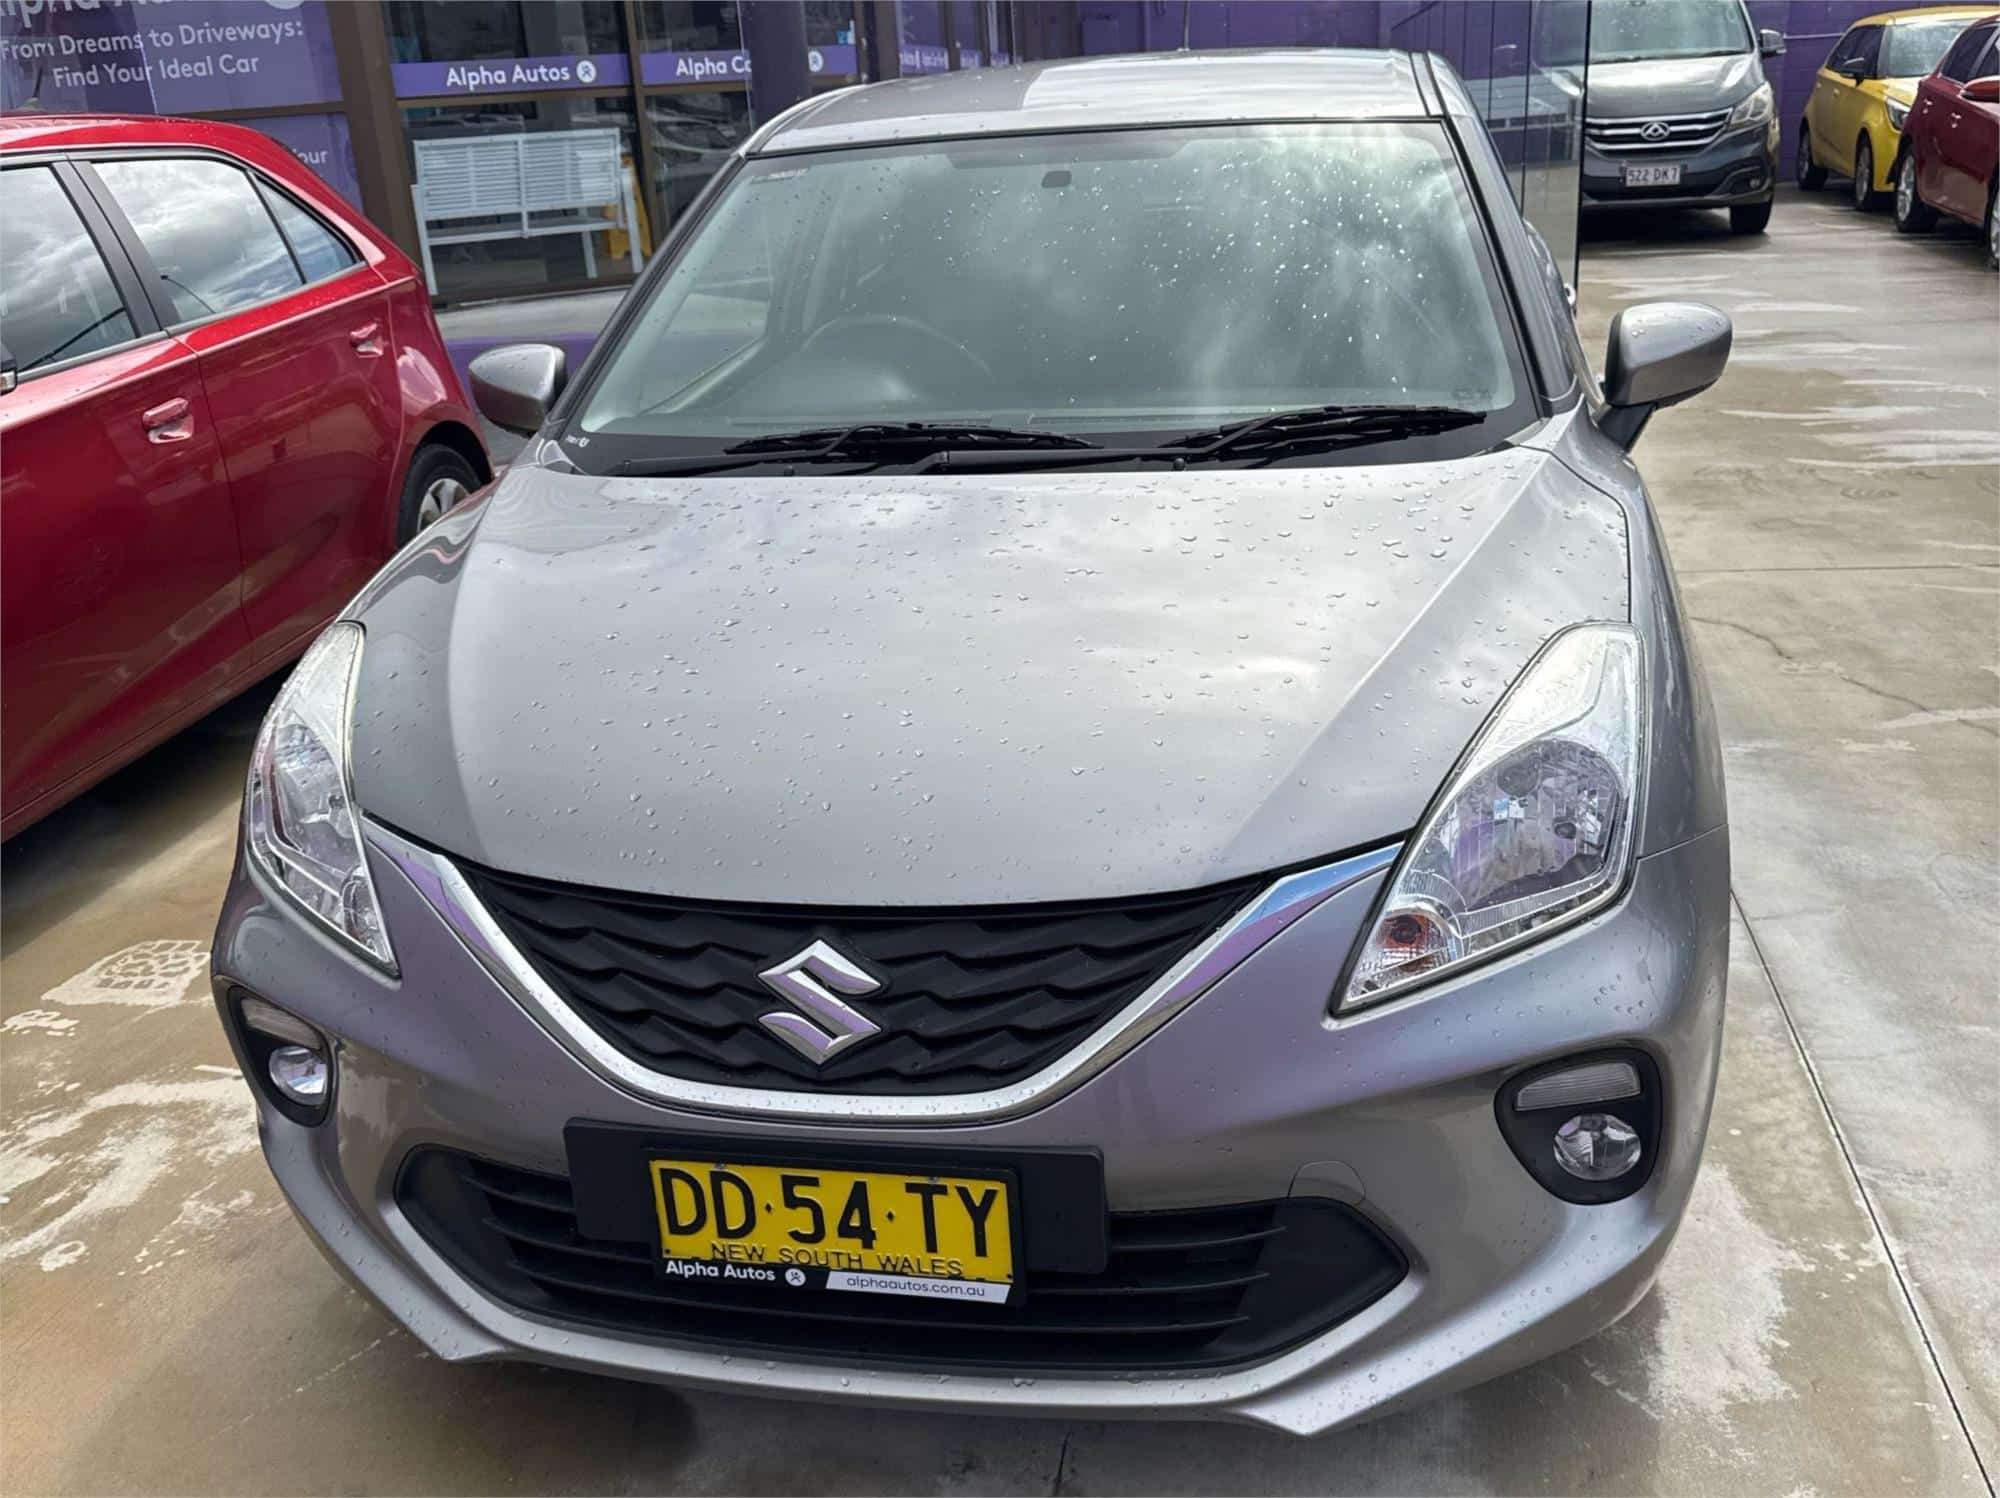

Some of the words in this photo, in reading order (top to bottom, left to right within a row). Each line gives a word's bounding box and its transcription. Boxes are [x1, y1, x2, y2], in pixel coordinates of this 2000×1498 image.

[0, 39, 55, 60] From
[58, 34, 143, 55] Dreams
[148, 28, 174, 48] to
[179, 21, 304, 45] Driveways:
[52, 63, 100, 88] Find
[102, 62, 153, 84] Your
[159, 55, 214, 80] Ideal
[219, 53, 259, 74] Car
[446, 65, 506, 91] Alpha
[511, 64, 571, 84] Autos
[675, 55, 728, 80] Alpha
[292, 148, 329, 164] our
[711, 1242, 766, 1262] NEW
[778, 1247, 864, 1270] SOUTH
[876, 1252, 963, 1277] WALES
[665, 1260, 720, 1278] Alpha
[723, 1264, 776, 1281] Autos
[846, 1275, 986, 1297] alphaautos.com.au
